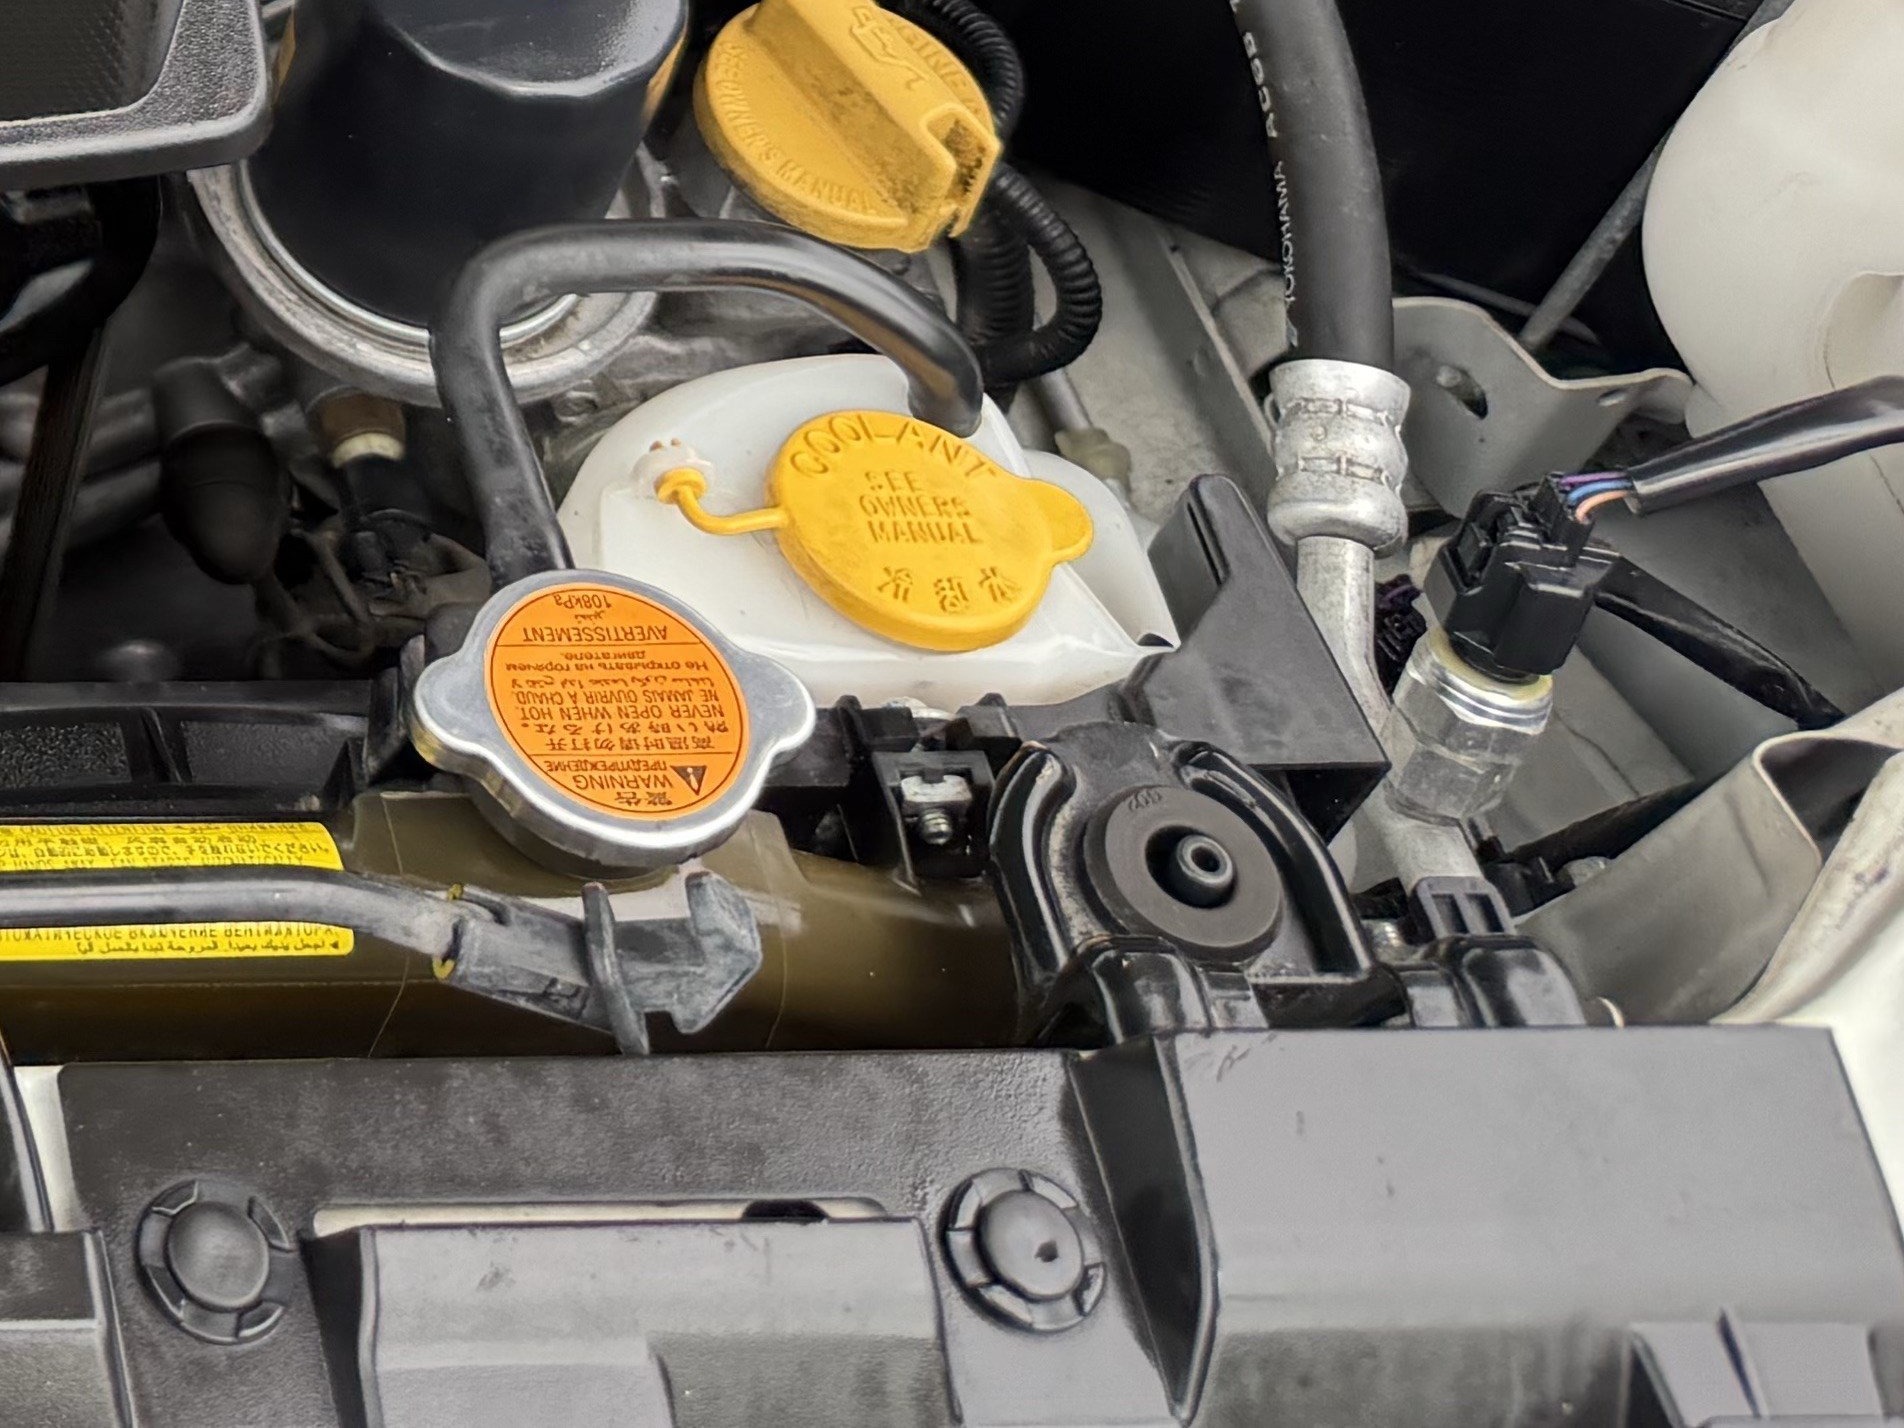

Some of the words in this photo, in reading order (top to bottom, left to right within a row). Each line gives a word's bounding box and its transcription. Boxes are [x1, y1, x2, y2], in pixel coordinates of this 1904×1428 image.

[789, 414, 998, 478] COOLANT
[864, 470, 923, 491] SEE
[859, 495, 972, 518] OWNERS
[867, 520, 983, 544] MANUAL
[554, 594, 612, 610] 108kPa
[522, 625, 668, 642] AVERTISSEMENT
[583, 690, 637, 705] OUVRIR
[642, 690, 693, 704] JAMAIS
[699, 689, 717, 704] NE
[515, 706, 552, 721] HOT.
[560, 707, 610, 720] WHEN
[616, 706, 662, 718] OPEN
[669, 704, 724, 717] NEVER
[572, 774, 672, 789] WARNING
